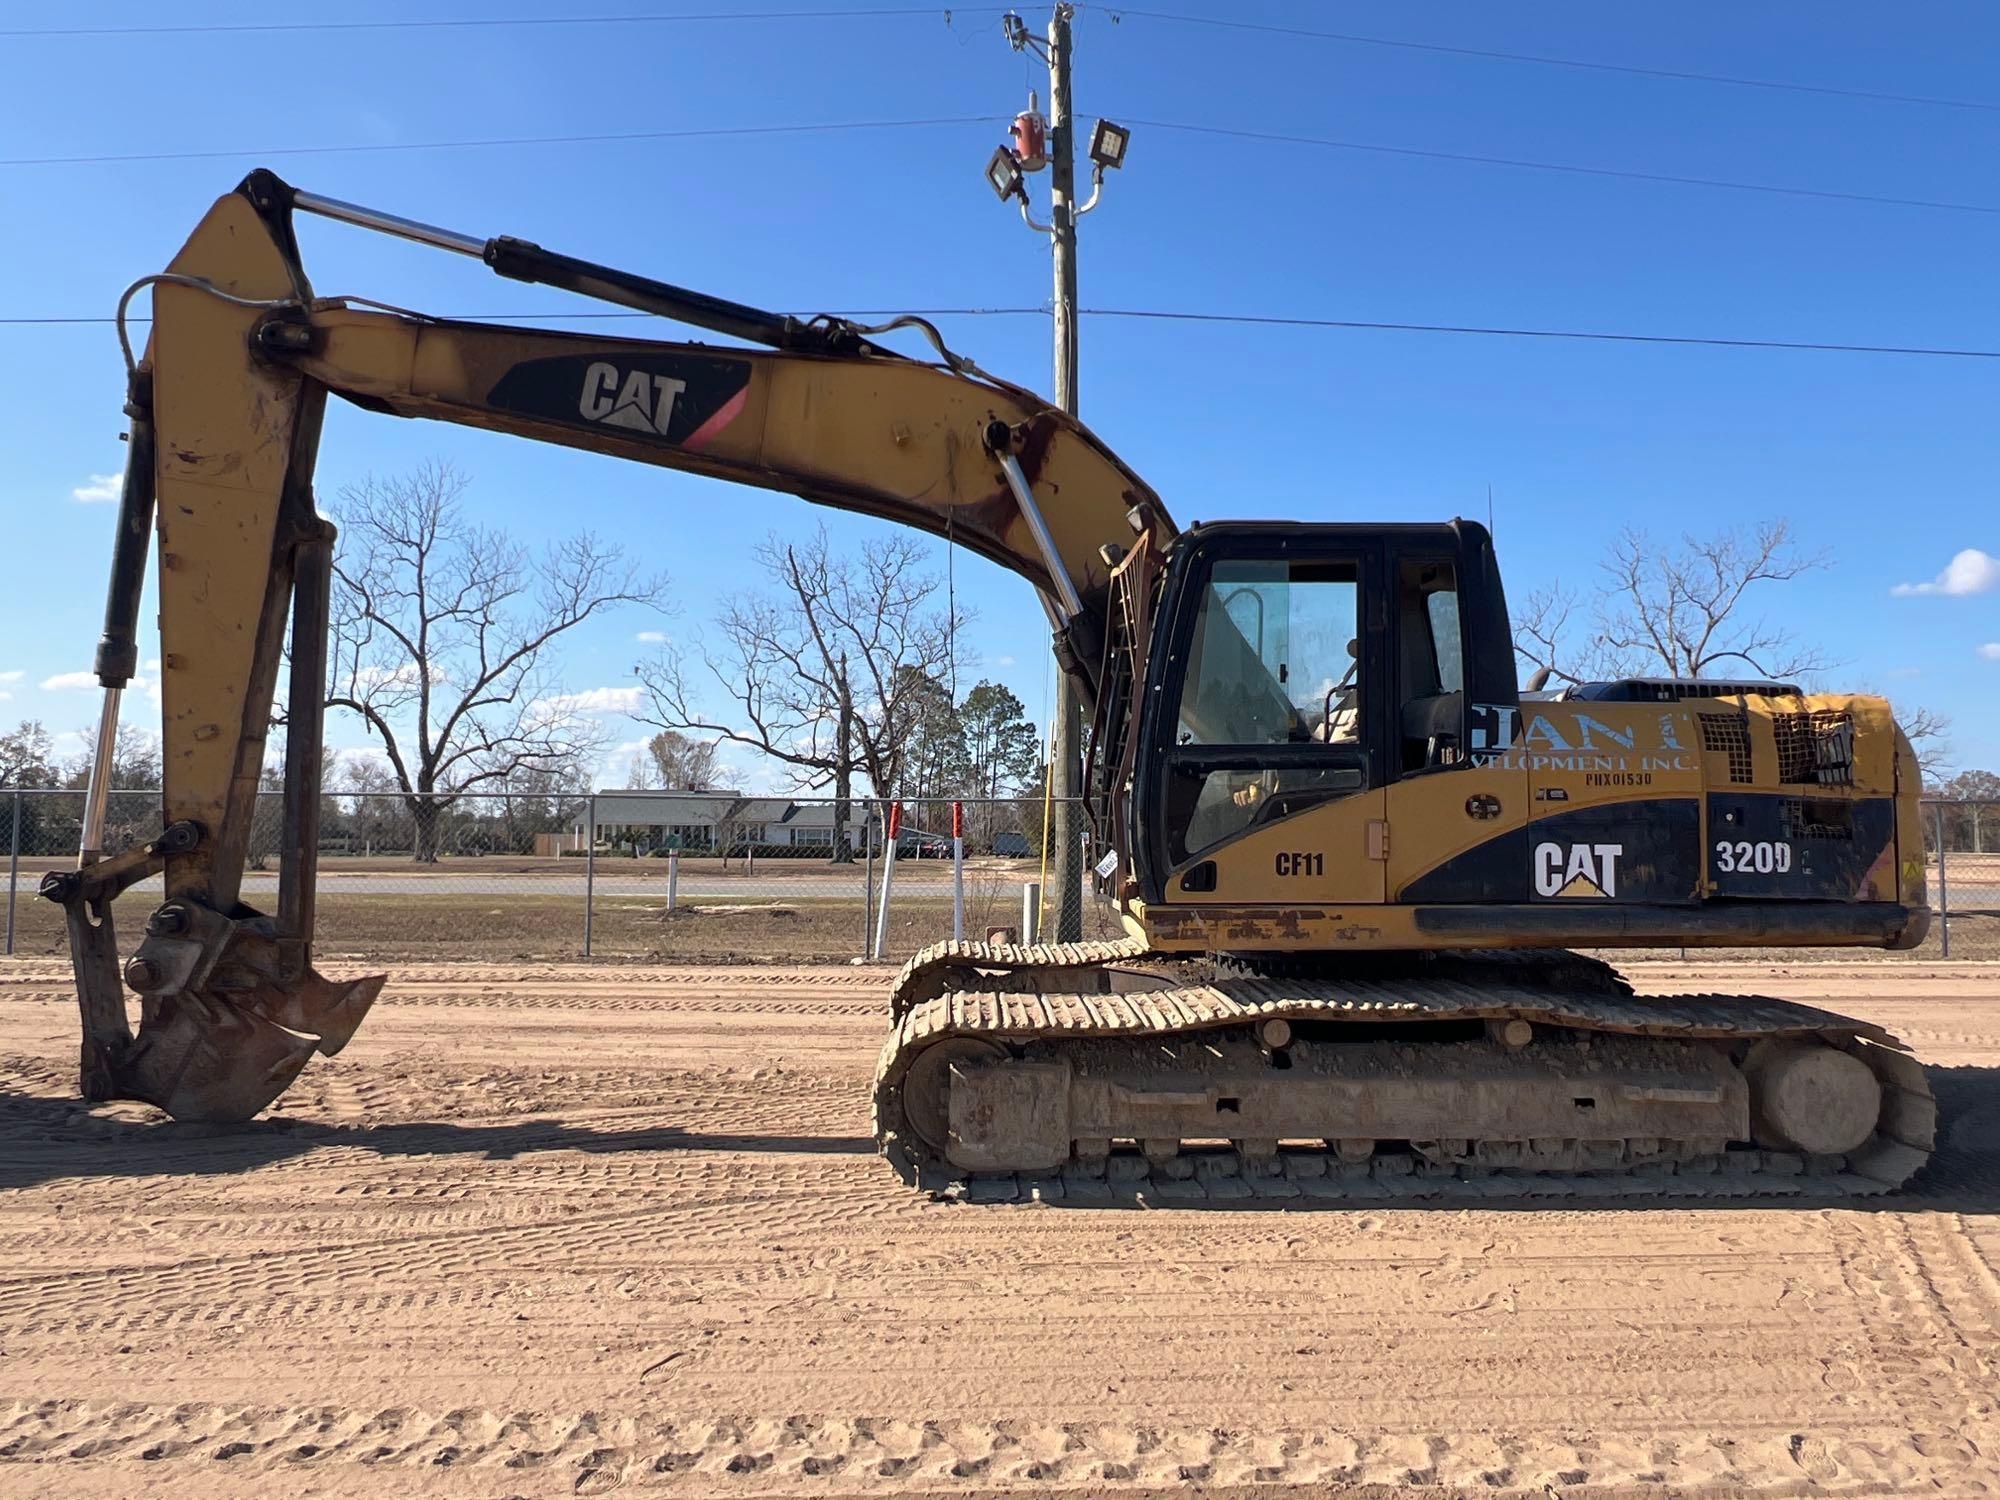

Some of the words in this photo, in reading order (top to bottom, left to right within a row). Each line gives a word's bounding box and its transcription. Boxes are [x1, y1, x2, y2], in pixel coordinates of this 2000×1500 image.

[579, 362, 686, 436] CAT
[1275, 852, 1323, 877] CF11
[1534, 842, 1623, 898] CAT
[1716, 841, 1791, 873] 320D
